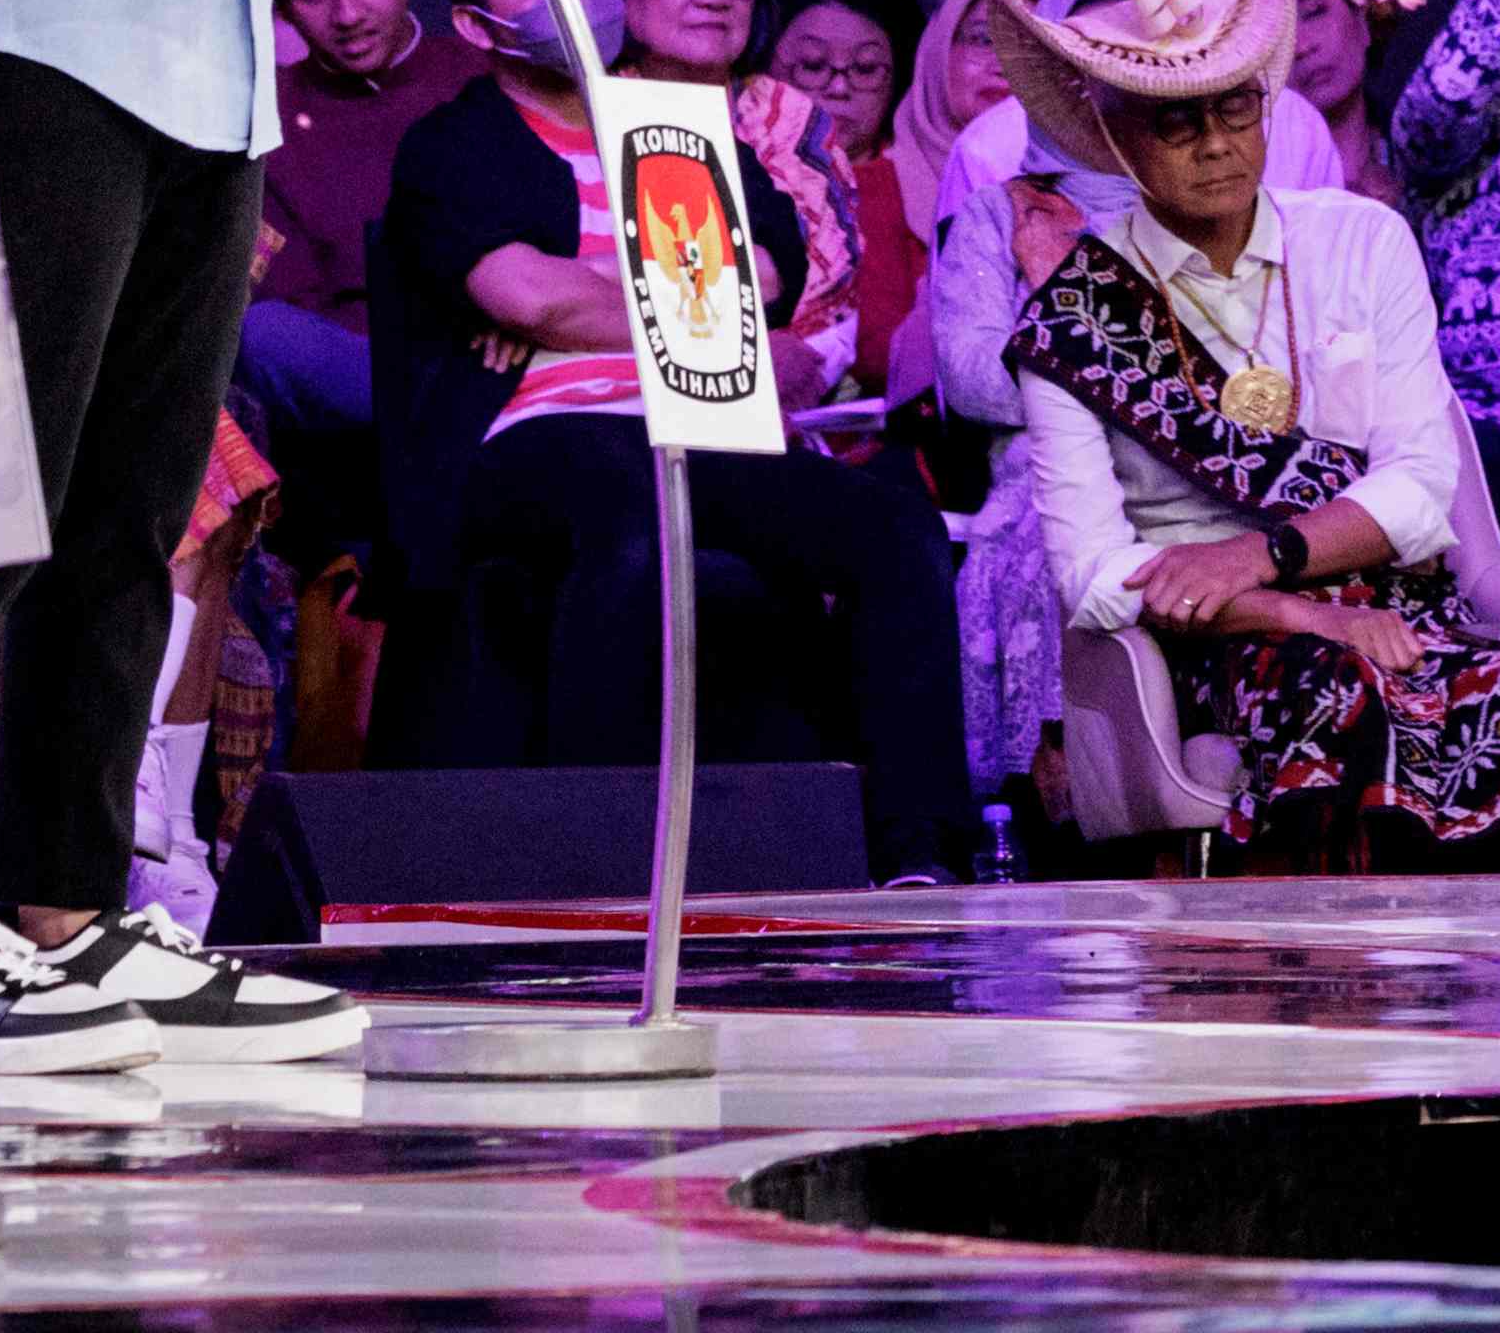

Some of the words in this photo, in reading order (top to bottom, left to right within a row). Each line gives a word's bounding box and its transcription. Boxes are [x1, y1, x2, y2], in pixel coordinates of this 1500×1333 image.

[632, 127, 706, 162] KOMISI
[633, 277, 731, 399] PEMILIHAN
[733, 283, 757, 395] UMUM
